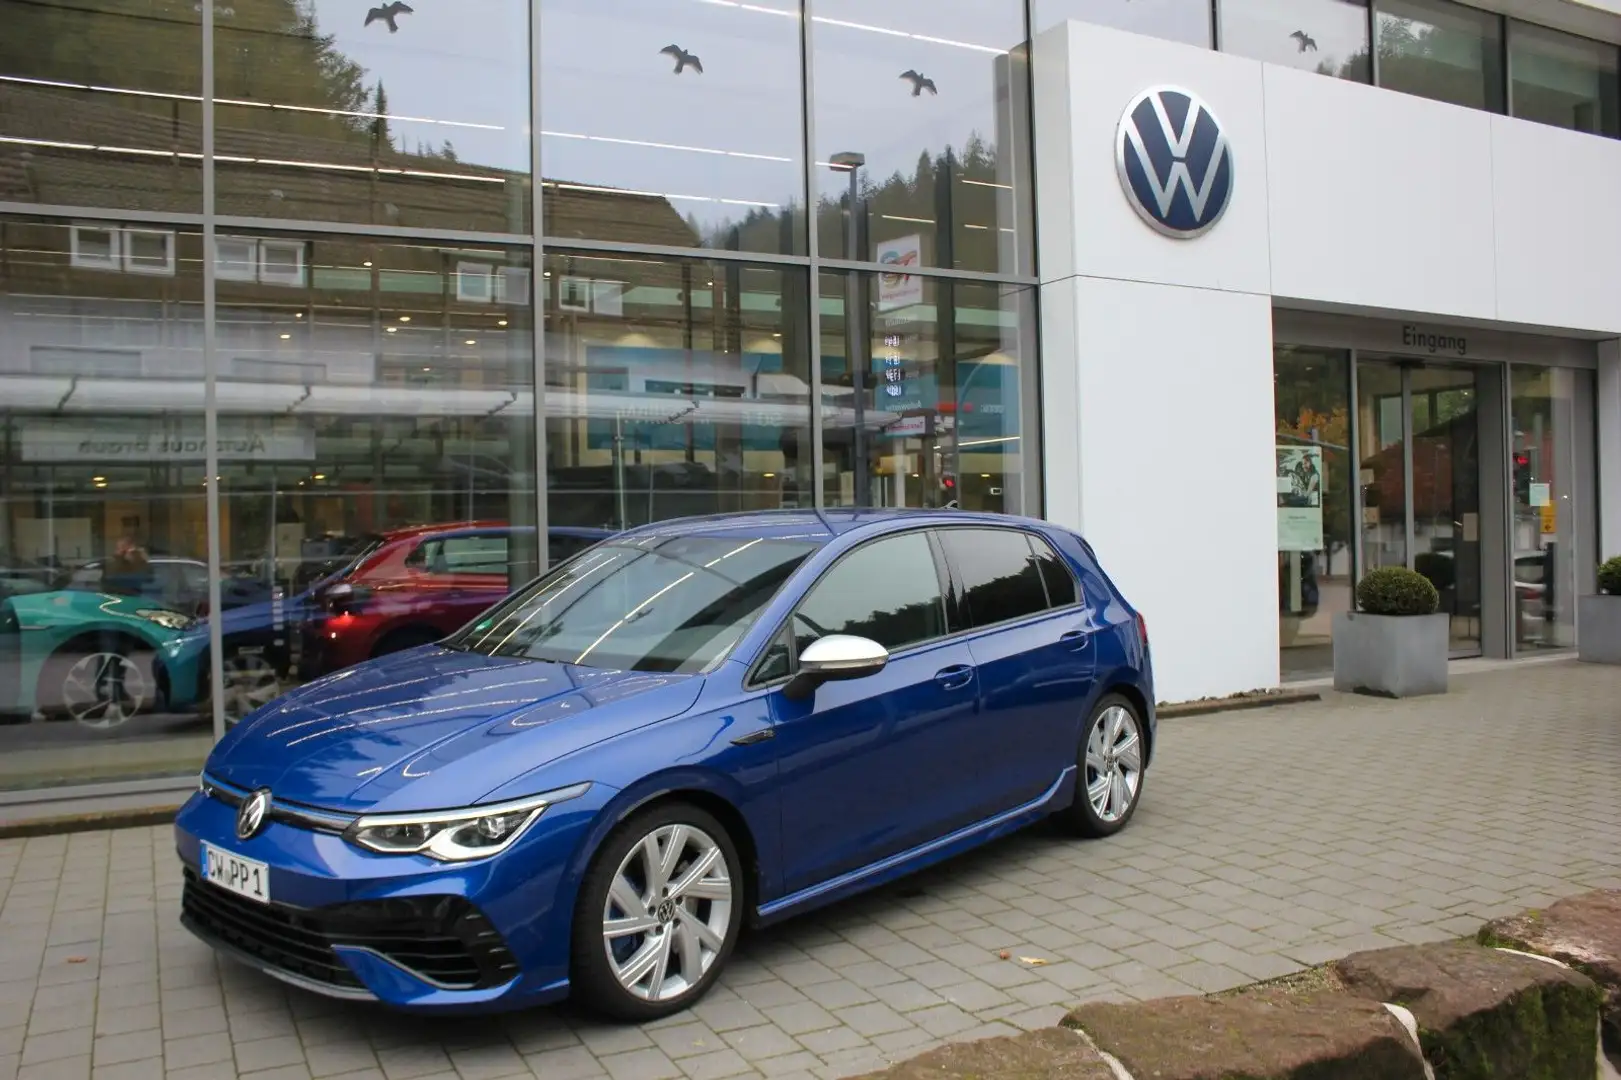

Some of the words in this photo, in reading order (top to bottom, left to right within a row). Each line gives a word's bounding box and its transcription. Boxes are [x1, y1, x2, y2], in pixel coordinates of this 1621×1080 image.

[1123, 91, 1230, 223] VW
[1402, 324, 1468, 356] Eingang
[229, 860, 249, 891] PP
[253, 868, 264, 896] 1
